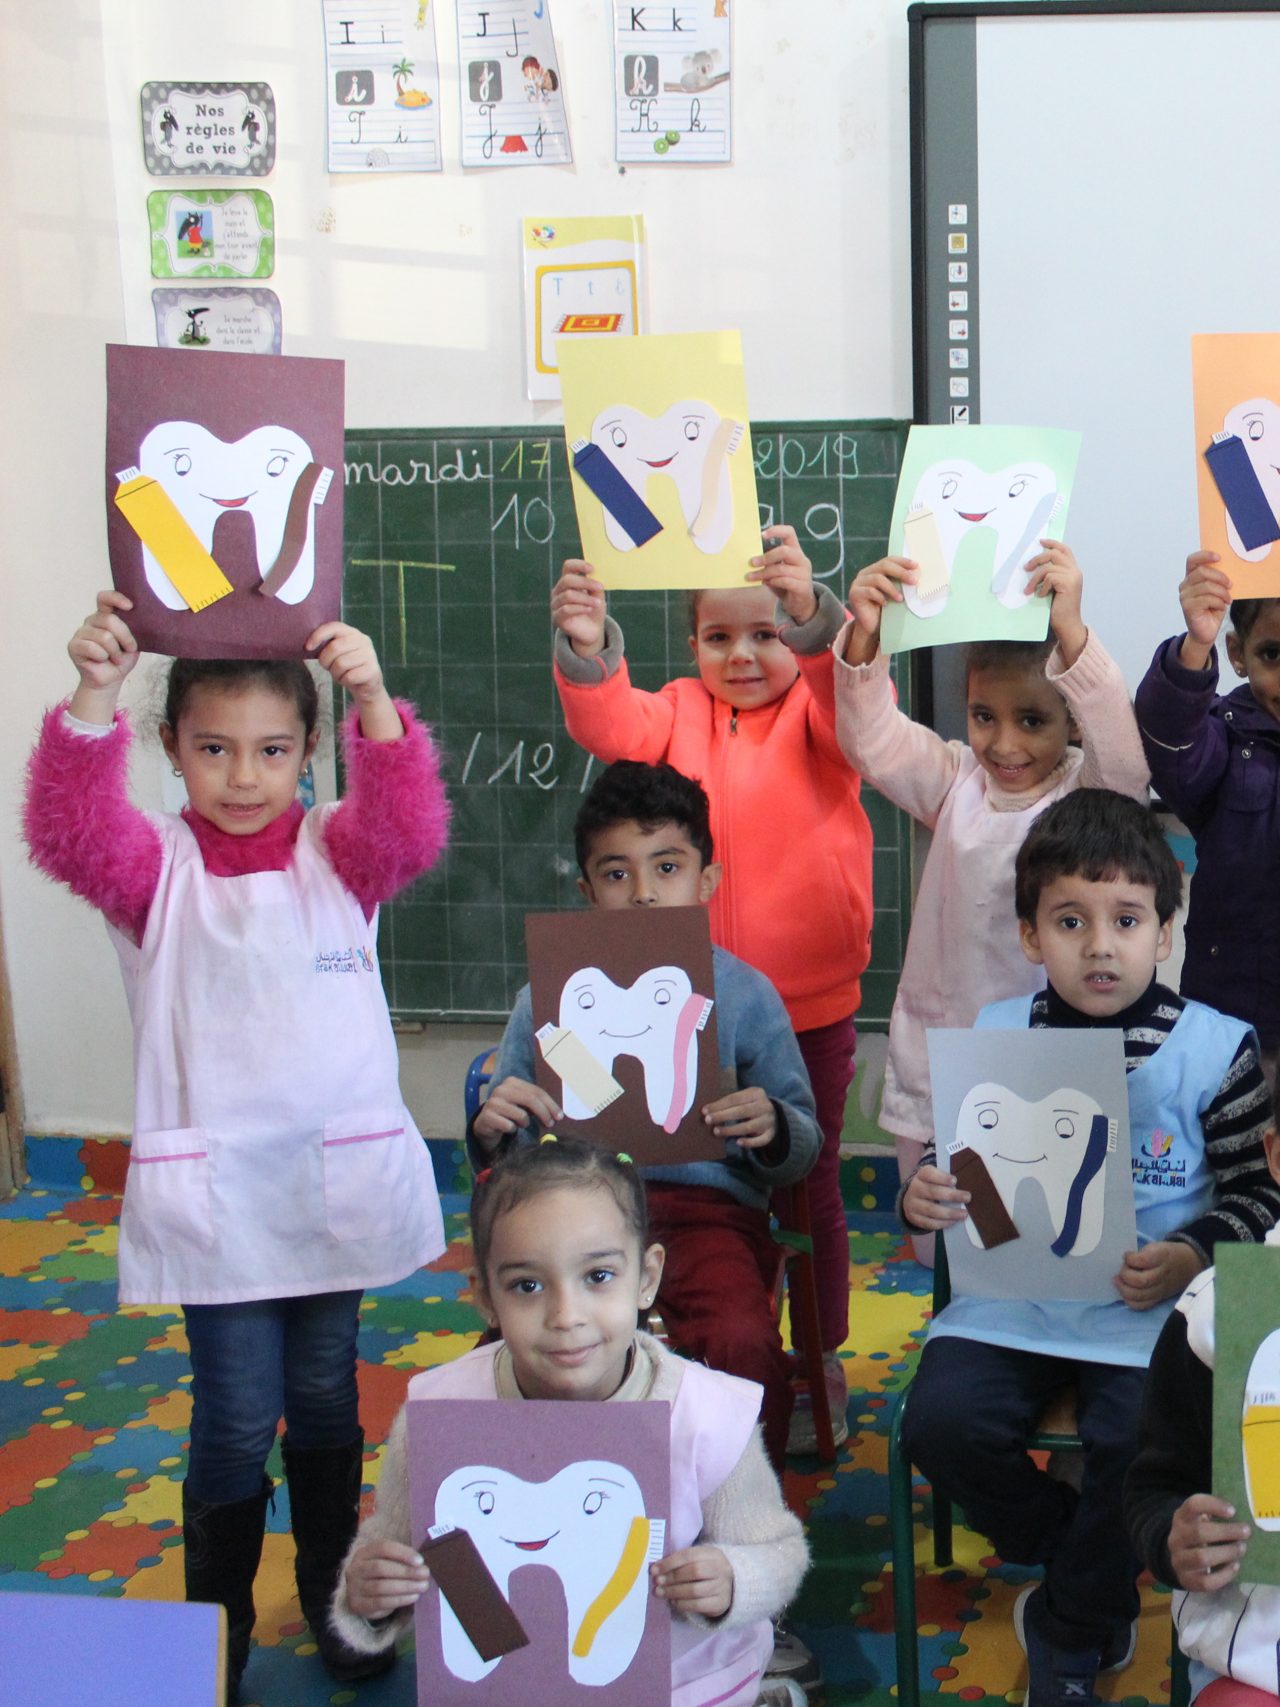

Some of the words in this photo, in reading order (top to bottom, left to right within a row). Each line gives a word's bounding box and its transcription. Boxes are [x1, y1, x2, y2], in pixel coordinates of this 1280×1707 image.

[631, 7, 647, 31] K
[672, 7, 683, 31] k
[339, 21, 356, 45] I
[380, 24, 385, 44] i
[476, 12, 490, 37] J
[505, 17, 519, 58] j
[344, 75, 367, 103] i
[195, 103, 225, 117] Nos
[185, 122, 236, 140] règles
[185, 141, 205, 155] de
[212, 141, 237, 155] vie
[344, 448, 494, 486] mardi
[500, 440, 550, 480] 17
[754, 434, 859, 479] 2019
[491, 493, 556, 551] 10
[351, 559, 457, 668] T
